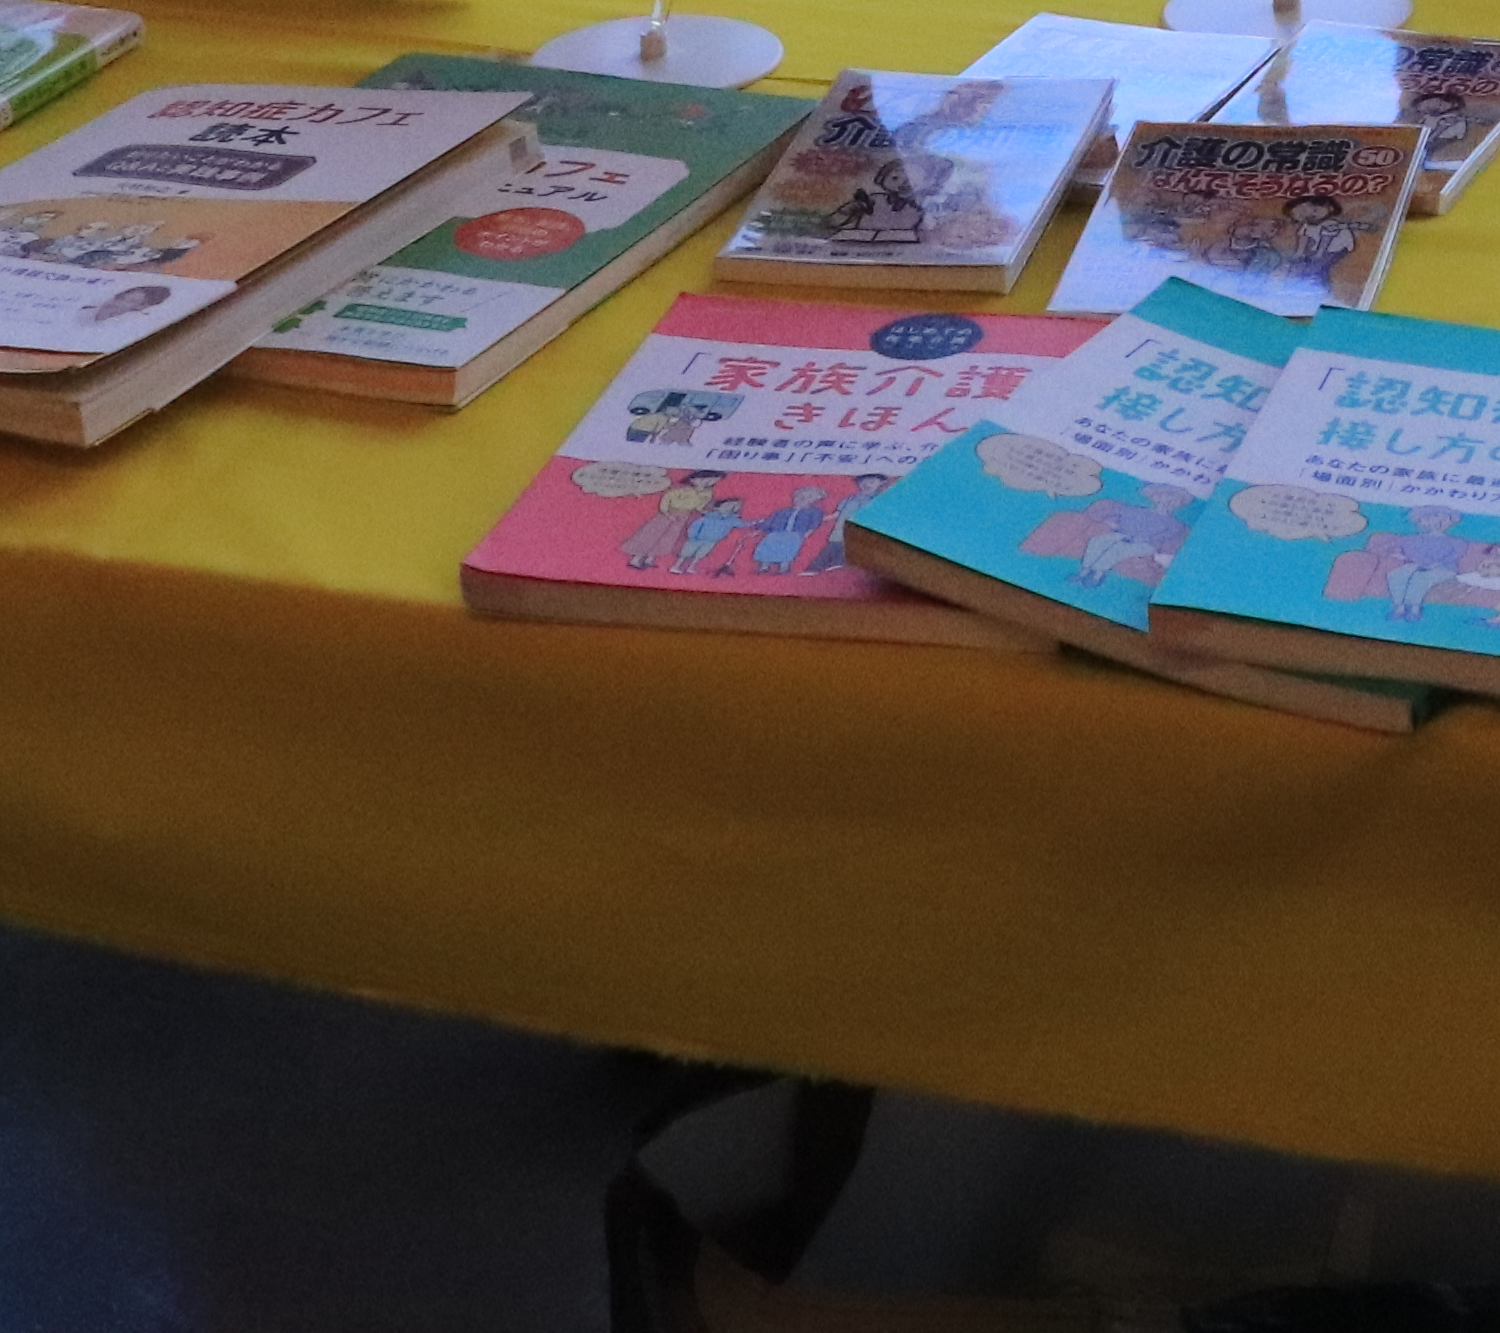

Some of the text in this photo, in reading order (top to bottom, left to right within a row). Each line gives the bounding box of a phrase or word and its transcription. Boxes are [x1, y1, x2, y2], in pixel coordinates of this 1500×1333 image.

[146, 99, 425, 127] 認知症カフェ
[1132, 135, 1353, 172] 介護の常識
[773, 403, 970, 434] きほん
